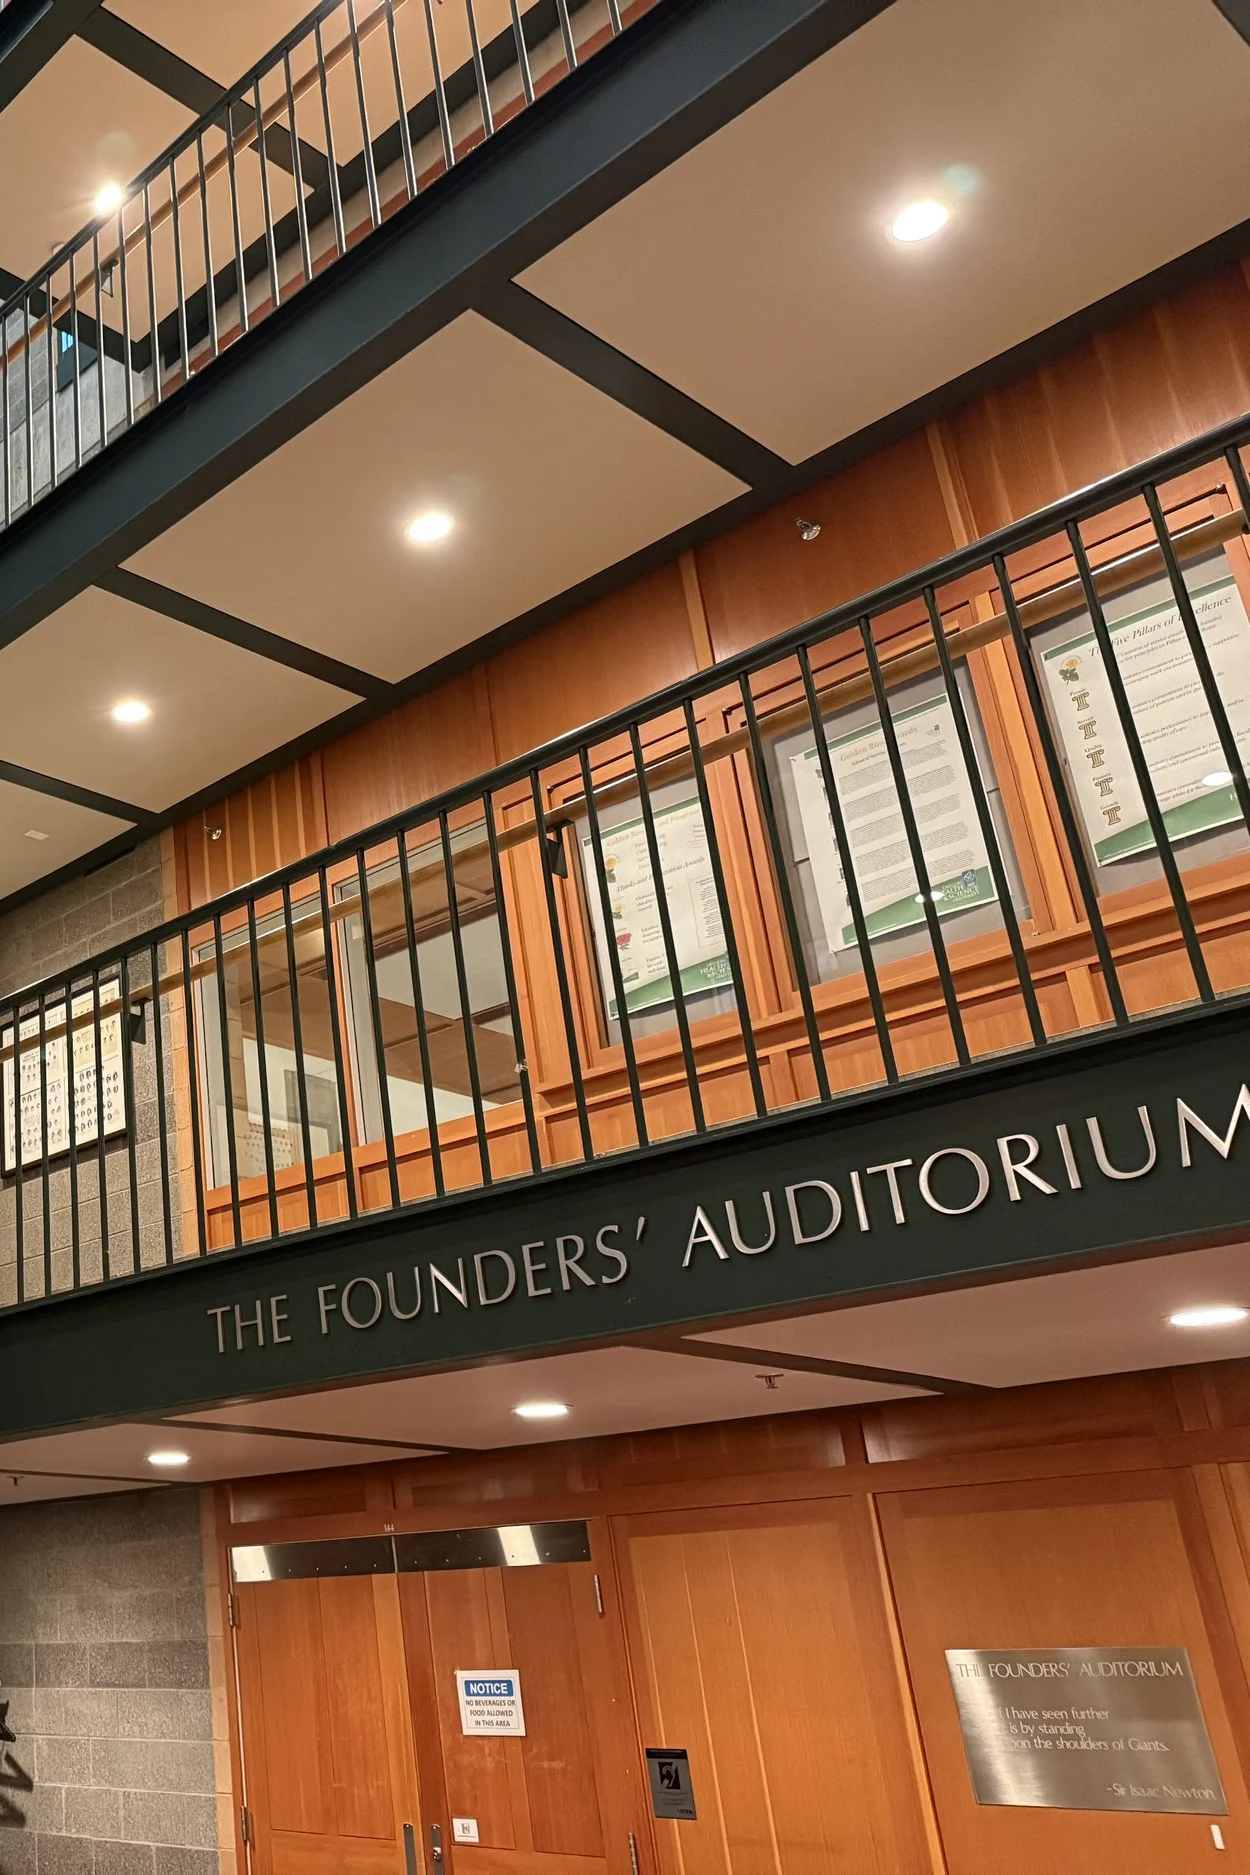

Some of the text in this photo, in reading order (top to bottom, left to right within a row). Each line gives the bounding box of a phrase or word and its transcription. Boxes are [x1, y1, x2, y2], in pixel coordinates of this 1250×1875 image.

[1132, 623, 1161, 640] Pillars
[1164, 614, 1175, 627] of
[1177, 597, 1231, 621] ellence
[840, 746, 868, 762] Golden
[206, 1083, 1250, 1353] THE FOUNDERS' AUDITORIUM
[956, 1661, 1184, 1678] THE FOUNDERS' AUDITORIUM
[469, 1682, 508, 1694] NOTICE
[486, 1709, 513, 1717] ALLOWED
[1011, 1706, 1039, 1719] have
[1041, 1710, 1069, 1719] seen
[1071, 1706, 1109, 1719] further
[1009, 1721, 1086, 1738] is by standing
[1034, 1736, 1053, 1749] the
[1056, 1736, 1109, 1750] shoulders
[1112, 1738, 1124, 1751] of
[1129, 1783, 1159, 1797] Isaac
[1161, 1784, 1216, 1800] Newton
